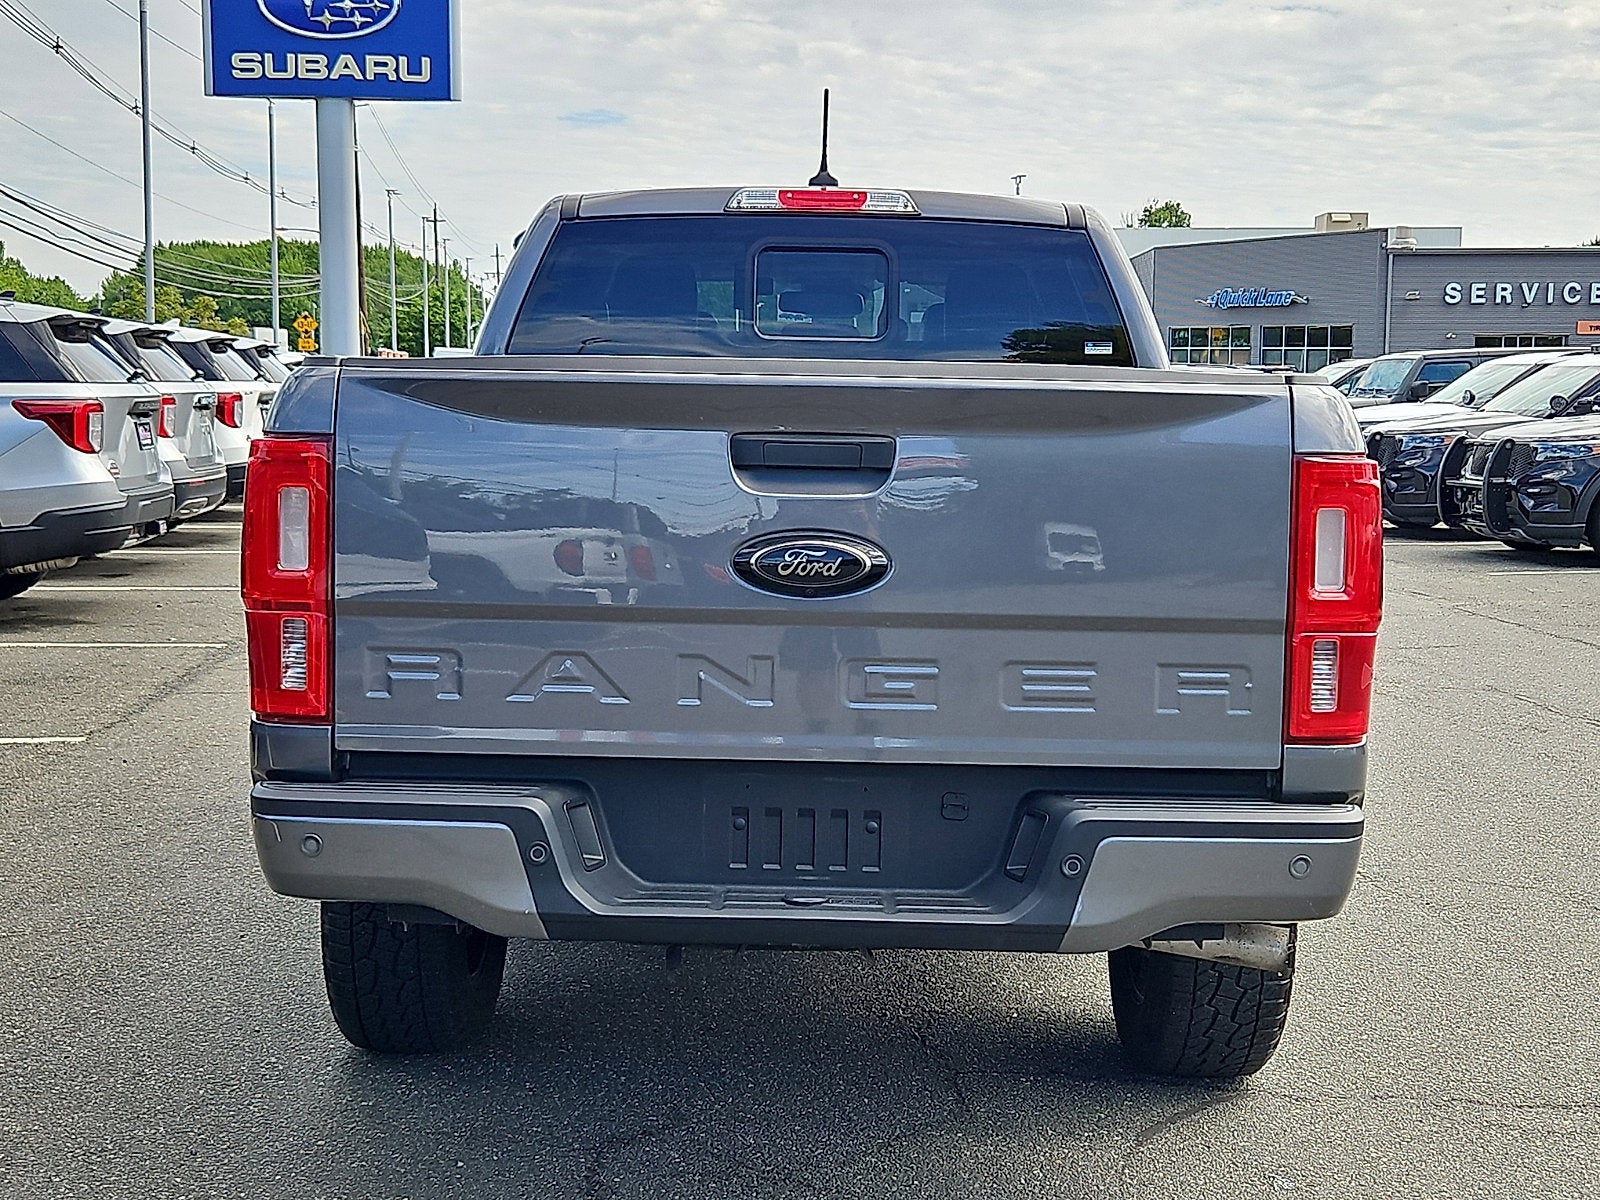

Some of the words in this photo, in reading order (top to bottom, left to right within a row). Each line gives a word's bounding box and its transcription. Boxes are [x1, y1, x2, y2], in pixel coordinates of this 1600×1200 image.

[231, 52, 431, 83] SUBARU
[1218, 287, 1257, 310] Quick
[1256, 287, 1294, 308] Lane
[1443, 281, 1600, 305] SERVICE
[777, 549, 843, 577] Ford
[364, 645, 1252, 716] RANGER
